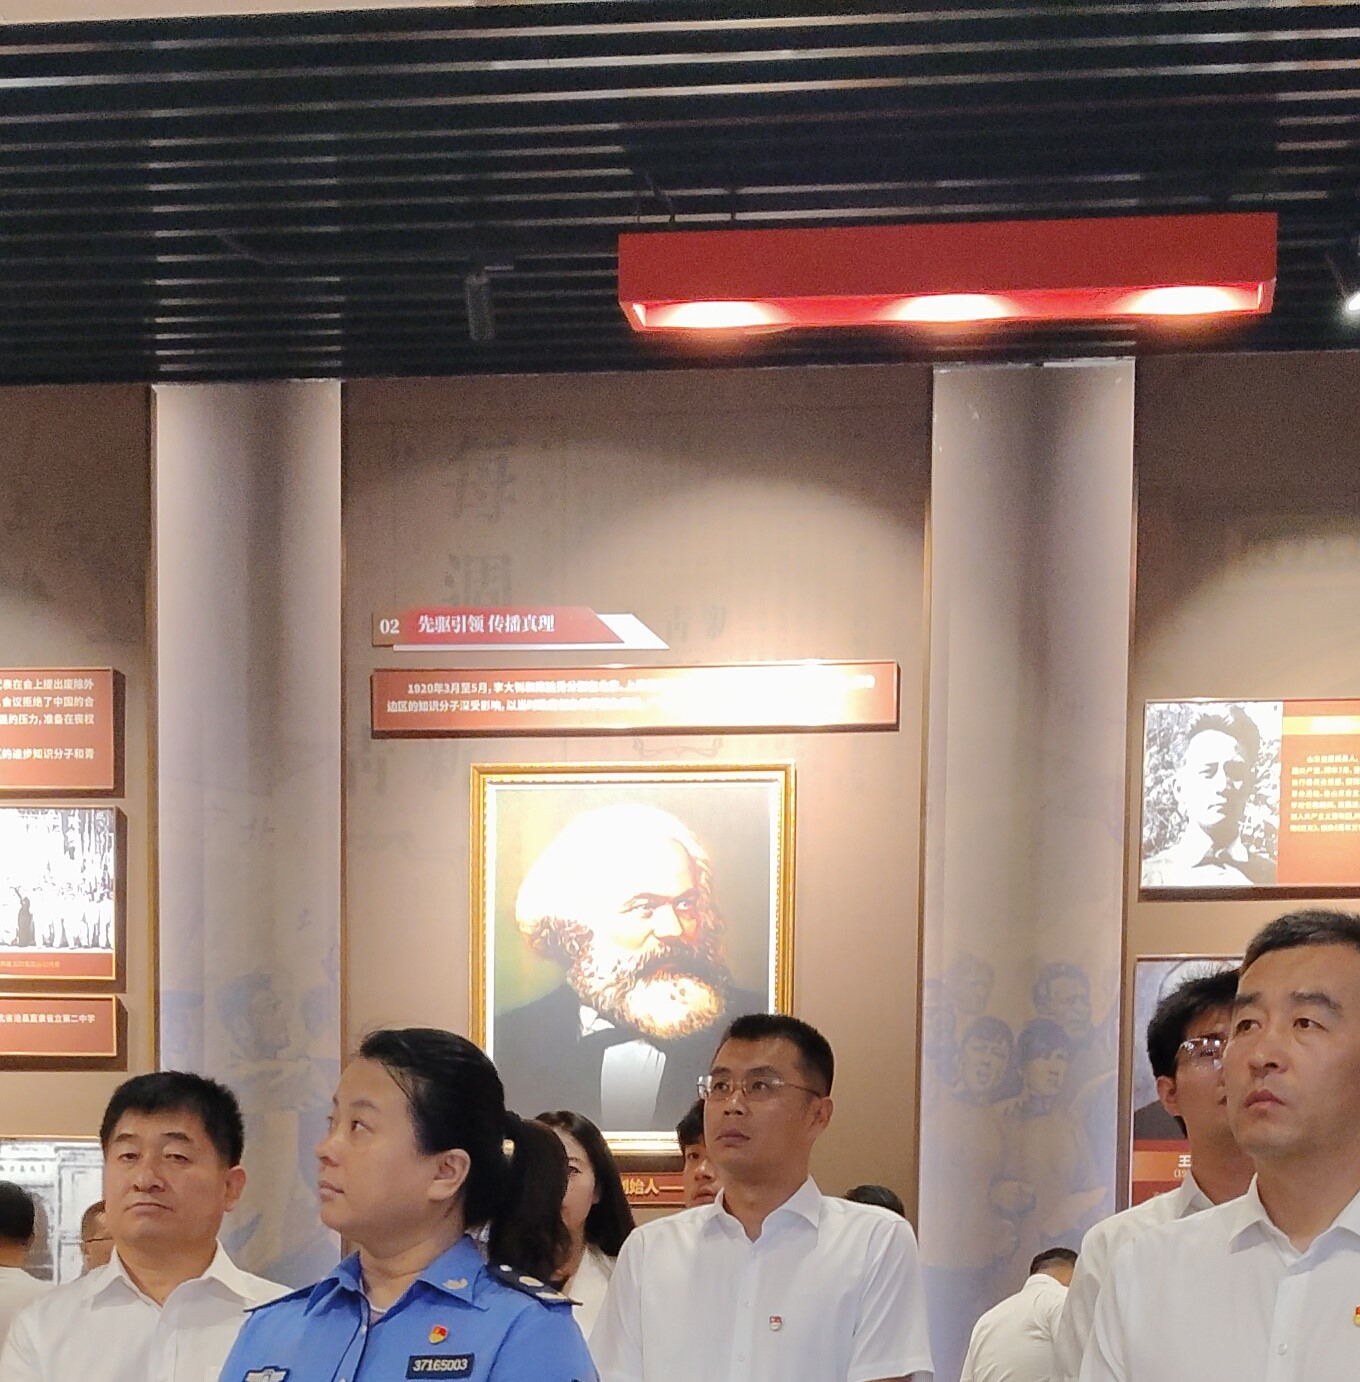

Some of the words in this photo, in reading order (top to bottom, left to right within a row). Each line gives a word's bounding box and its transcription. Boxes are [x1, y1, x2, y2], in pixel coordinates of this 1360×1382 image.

[379, 618, 400, 635] 02
[418, 614, 485, 633] 先驱引领
[489, 614, 555, 633] 传播真理
[412, 1358, 469, 1372] 37165003
